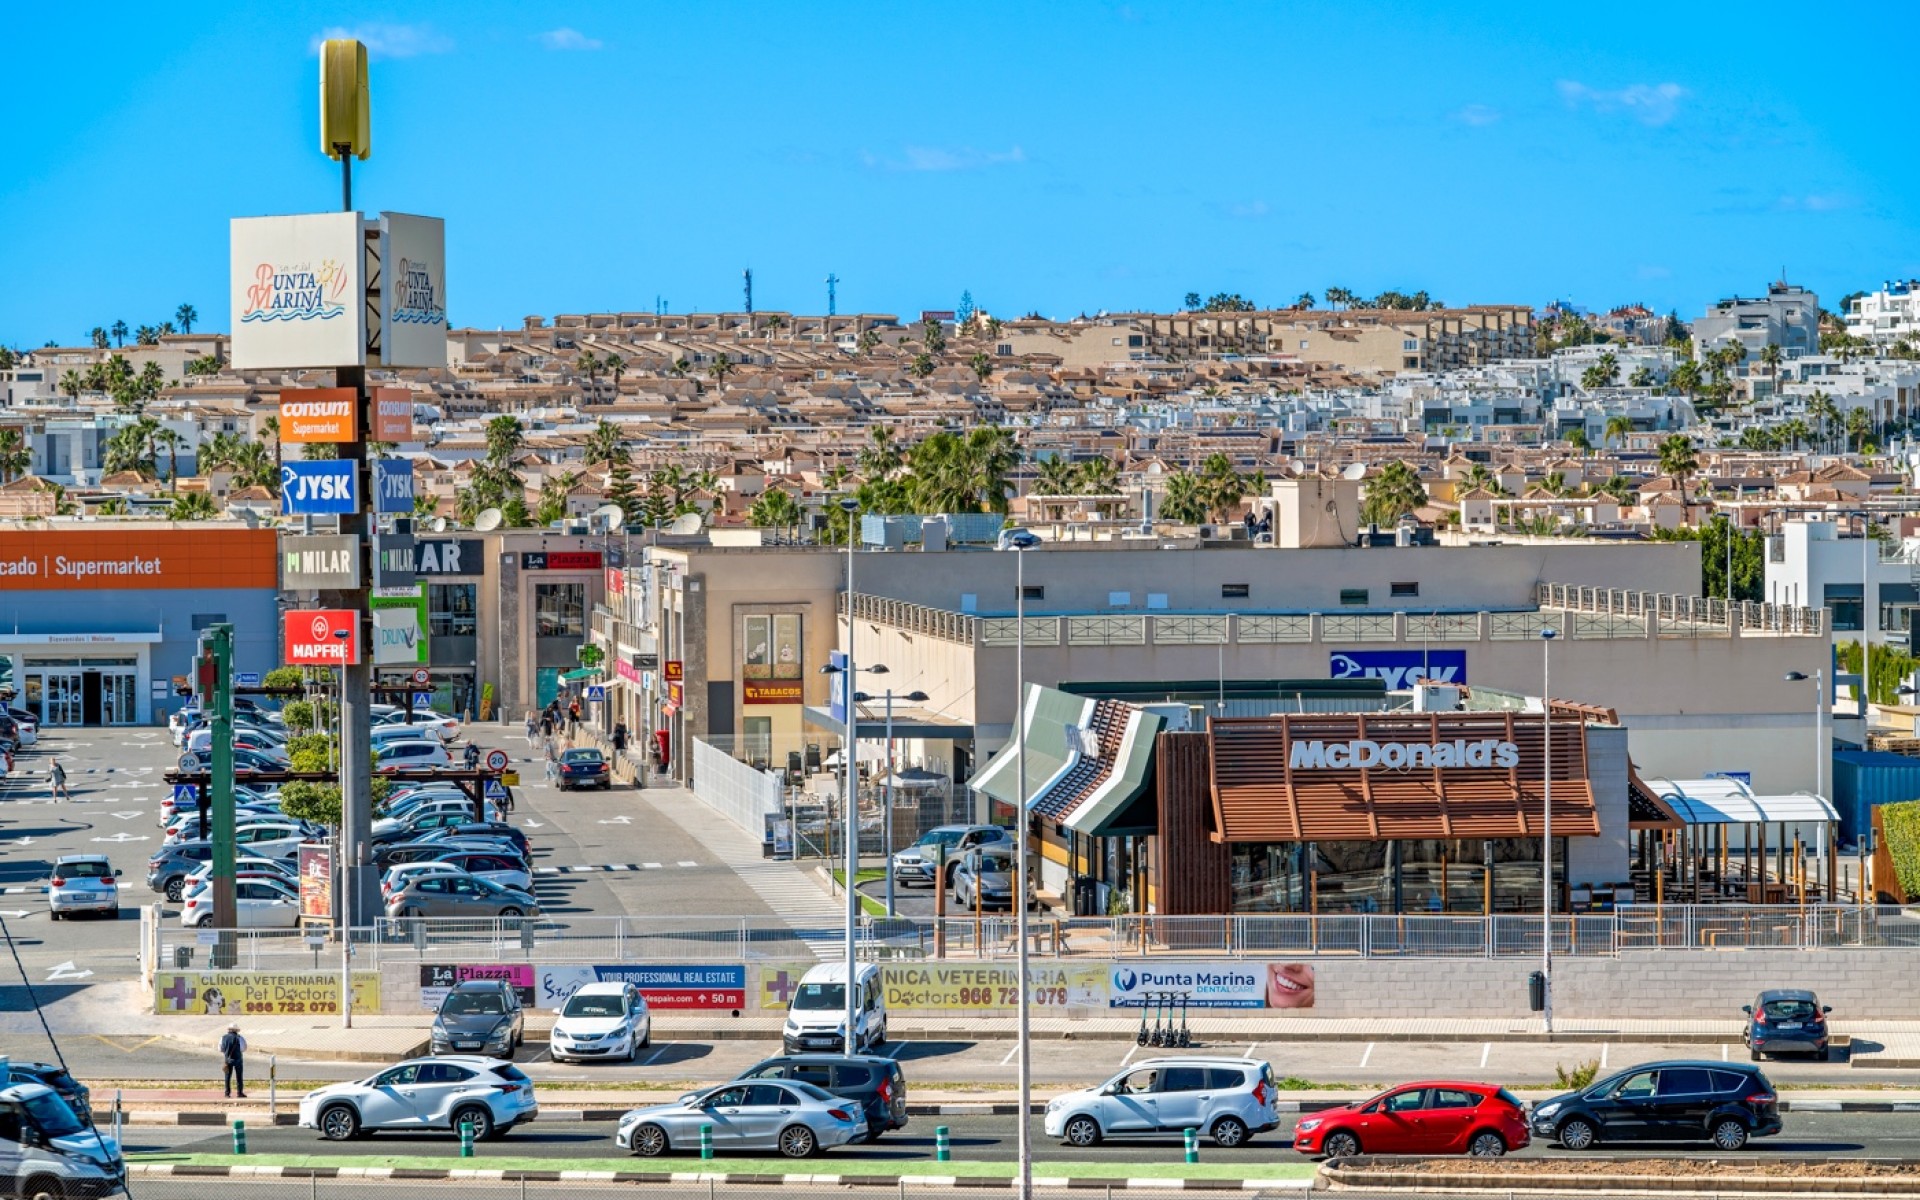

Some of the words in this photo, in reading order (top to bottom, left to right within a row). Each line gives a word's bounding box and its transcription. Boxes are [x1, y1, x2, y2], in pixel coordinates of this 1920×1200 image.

[255, 263, 317, 291] PUNTA
[399, 257, 430, 291] PUNTA
[243, 284, 324, 315] MARINA
[392, 280, 434, 315] MARINA
[281, 400, 351, 417] consum
[378, 400, 411, 417] consum
[292, 421, 340, 437] Supermarket
[383, 421, 407, 435] Supermarket
[295, 475, 351, 500] JYSK
[386, 474, 412, 498] JYSK
[302, 549, 351, 574] MILAR
[389, 549, 414, 572] MILAR
[415, 543, 462, 572] AR
[527, 554, 544, 564] La
[55, 555, 161, 580] Supermarket
[48, 635, 85, 643] Bienvenidos
[292, 644, 348, 658] MAPFRE
[1363, 666, 1459, 691] YS
[758, 688, 801, 696] TABACOS
[491, 757, 504, 765] 20
[1289, 739, 1519, 768] McDonald's
[182, 758, 196, 767] 20
[201, 974, 250, 986] CLÍNICA
[253, 976, 336, 986] VETERINARIA
[433, 967, 454, 980] La
[459, 967, 512, 980] Plazza
[601, 972, 622, 983] YOUR
[624, 972, 682, 983] PROFESSIONAL
[684, 972, 704, 983] REAL
[706, 972, 736, 983] ESTATE
[885, 969, 931, 985] NICA
[1141, 972, 1193, 986] Punta
[1197, 971, 1256, 986] Marina
[245, 987, 269, 1001] Pet
[711, 994, 725, 1004] 50
[727, 995, 737, 1003] m
[959, 987, 992, 1005] 966
[999, 987, 1030, 1005] 72
[1036, 987, 1068, 1005] 079
[246, 1002, 274, 1012] 966
[278, 1002, 305, 1012] 722
[309, 1002, 337, 1012] 079
